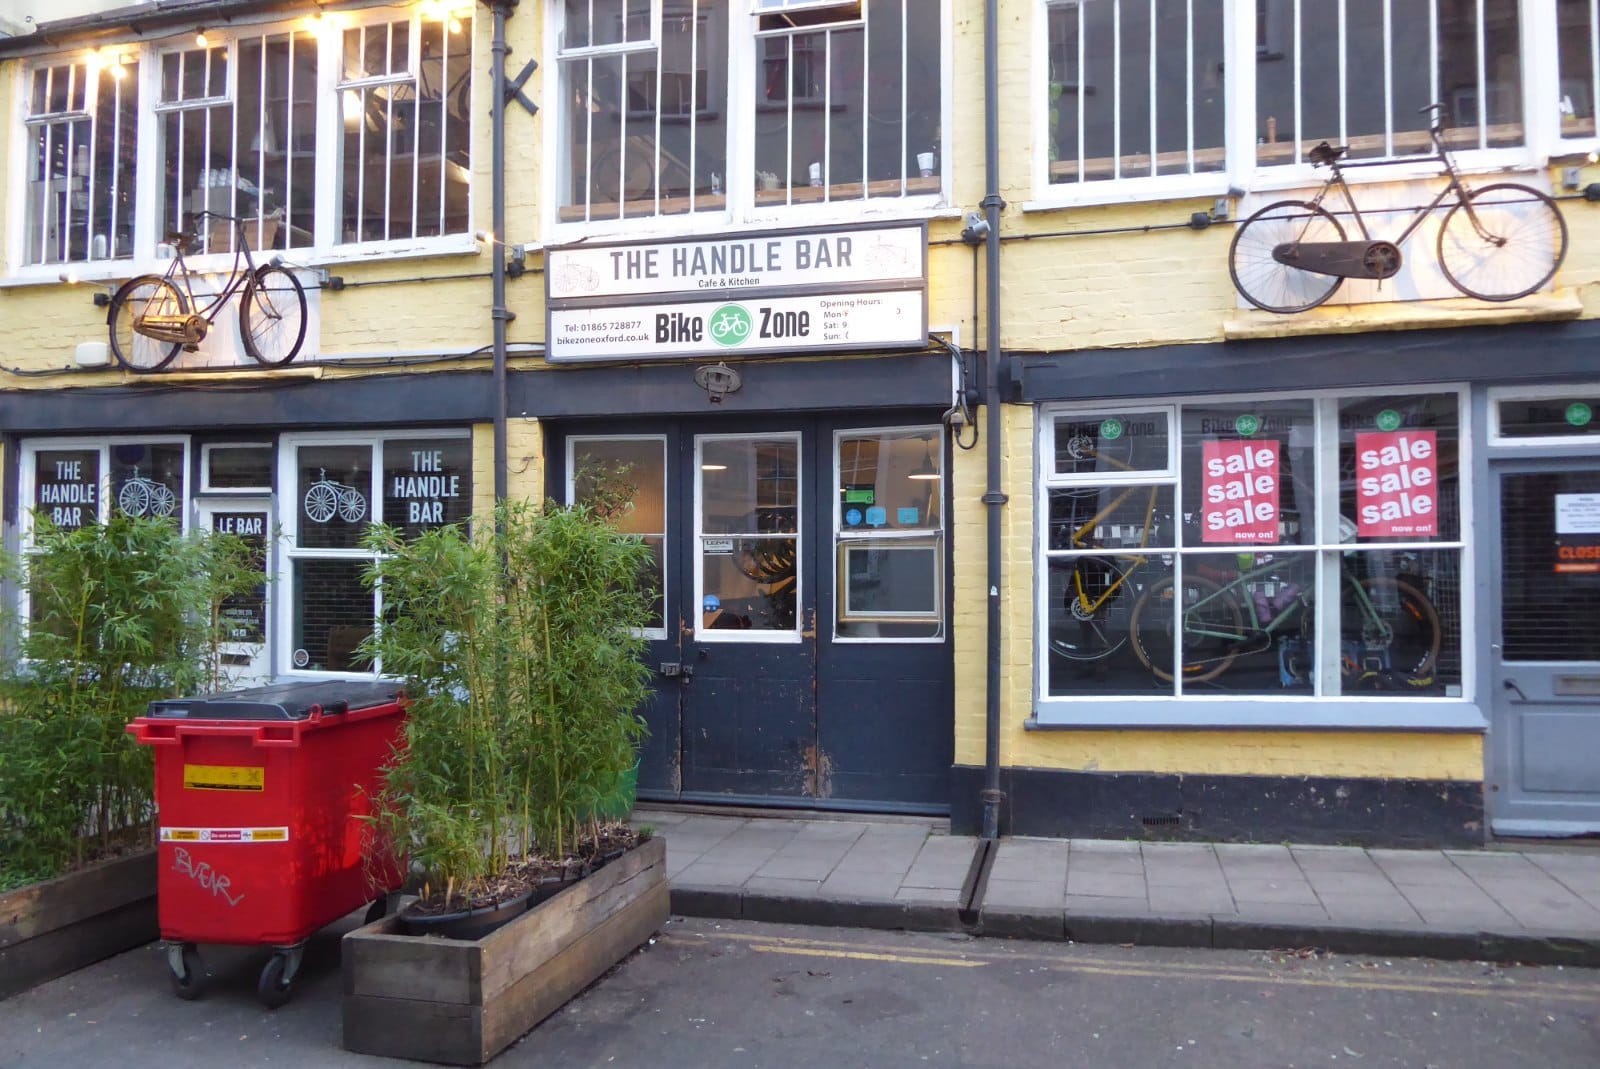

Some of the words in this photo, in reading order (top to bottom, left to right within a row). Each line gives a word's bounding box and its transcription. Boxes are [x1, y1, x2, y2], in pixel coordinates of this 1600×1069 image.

[609, 249, 660, 281] THE
[672, 241, 782, 278] HANDLE
[795, 236, 853, 270] BAR
[698, 278, 719, 289] Cafe
[719, 278, 727, 288] &
[728, 276, 760, 288] Kitchen
[819, 298, 855, 309] Opening
[856, 297, 884, 307] Hours:
[564, 323, 579, 333] Tel:
[580, 322, 608, 332] 01865
[609, 320, 642, 331] 728877
[655, 311, 704, 344] Bike
[759, 307, 811, 340] Zone
[823, 321, 840, 330] Sat:
[823, 331, 842, 341] Sun:
[556, 333, 650, 346] bikezoneoxford.co.uk
[411, 450, 443, 472] THE
[1207, 445, 1275, 478] sale
[1360, 436, 1433, 471] sale
[55, 460, 82, 480] THE
[1361, 464, 1433, 497] sale
[41, 483, 96, 504] HANDLE
[394, 475, 461, 499] HANDLE
[1207, 472, 1275, 504] sale
[53, 506, 82, 527] BAR
[409, 501, 444, 523] BAR
[1207, 499, 1275, 531] sale
[1361, 491, 1433, 525] sale
[219, 517, 234, 535] LE
[236, 517, 263, 535] BAR
[1234, 531, 1256, 539] now
[1258, 530, 1274, 539] on!
[1391, 525, 1414, 533] now
[1415, 523, 1432, 533] on!
